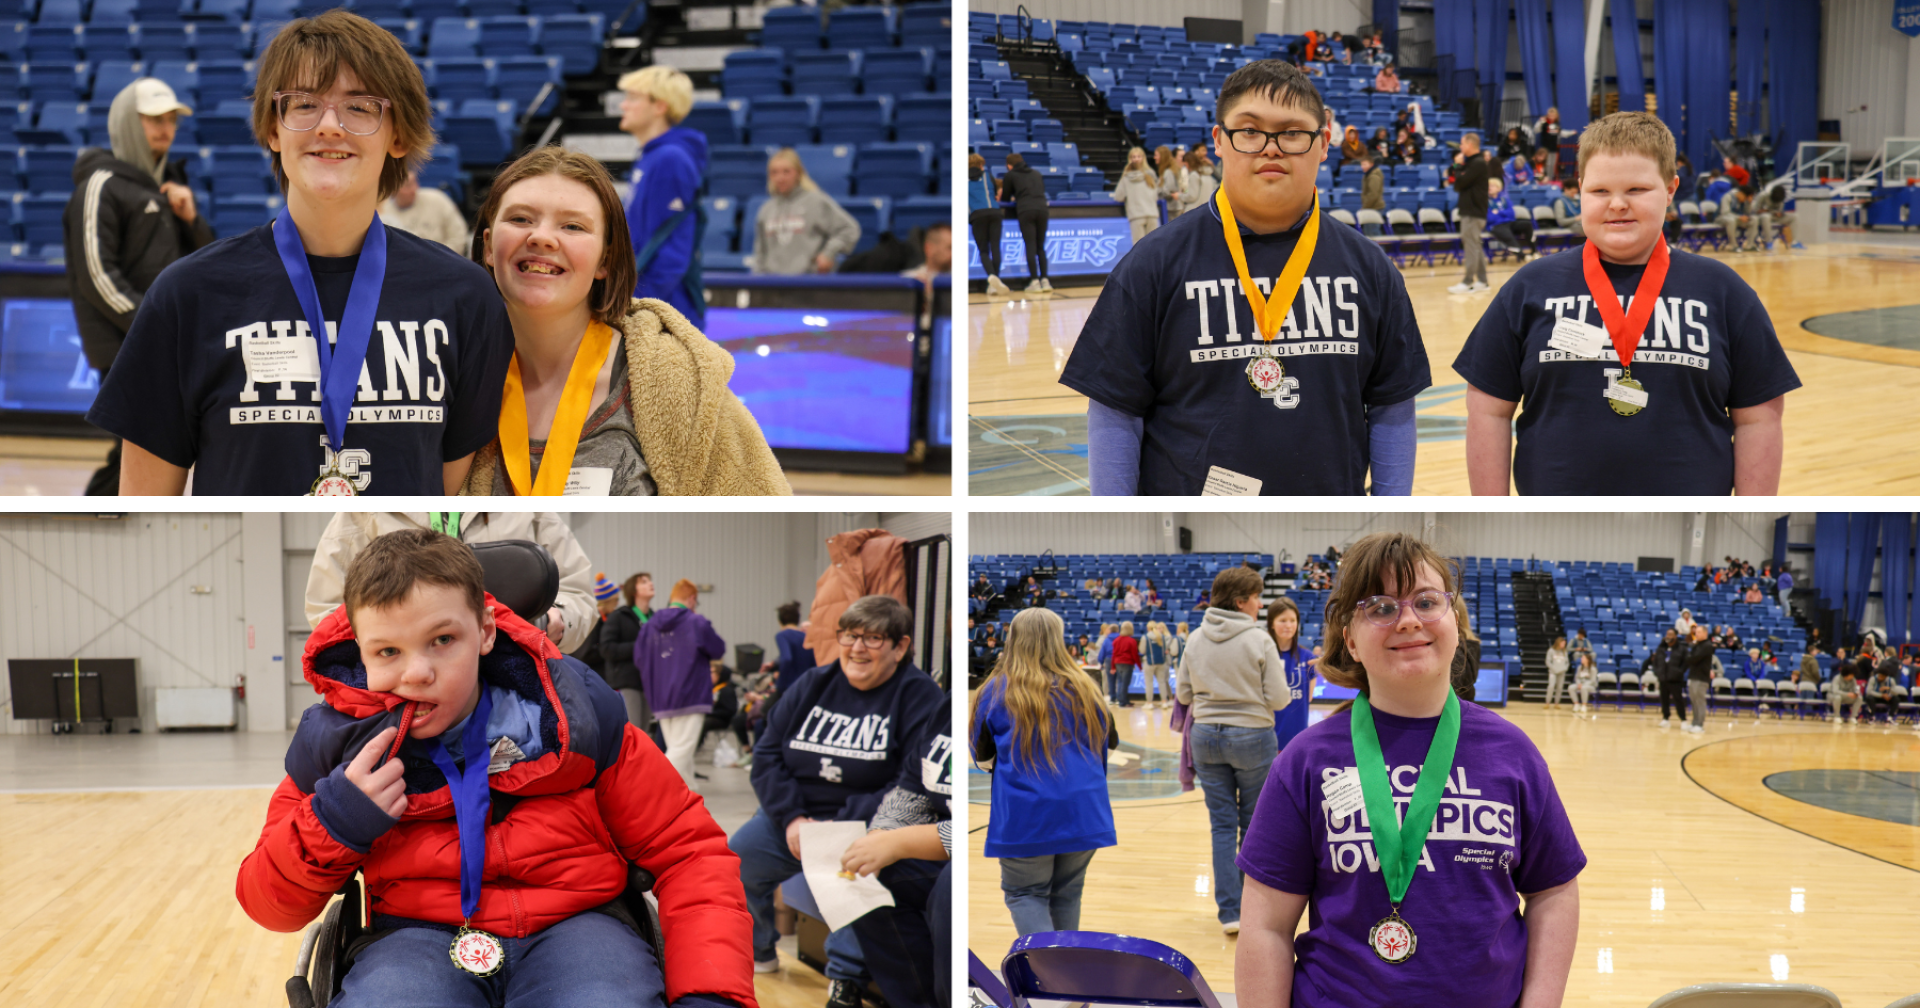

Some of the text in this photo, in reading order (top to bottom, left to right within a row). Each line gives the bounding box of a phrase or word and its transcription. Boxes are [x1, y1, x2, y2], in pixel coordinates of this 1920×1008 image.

[1545, 295, 1710, 354] TINS
[1198, 344, 1356, 360] SPECIAL OLYMPICS
[1545, 351, 1704, 367] SPEL LYMPICS
[239, 409, 316, 421] SPECIA
[796, 705, 890, 750] TITANS
[1328, 802, 1514, 839] OLPICS
[1454, 855, 1495, 864] Olympics
[1462, 847, 1495, 856] Special
